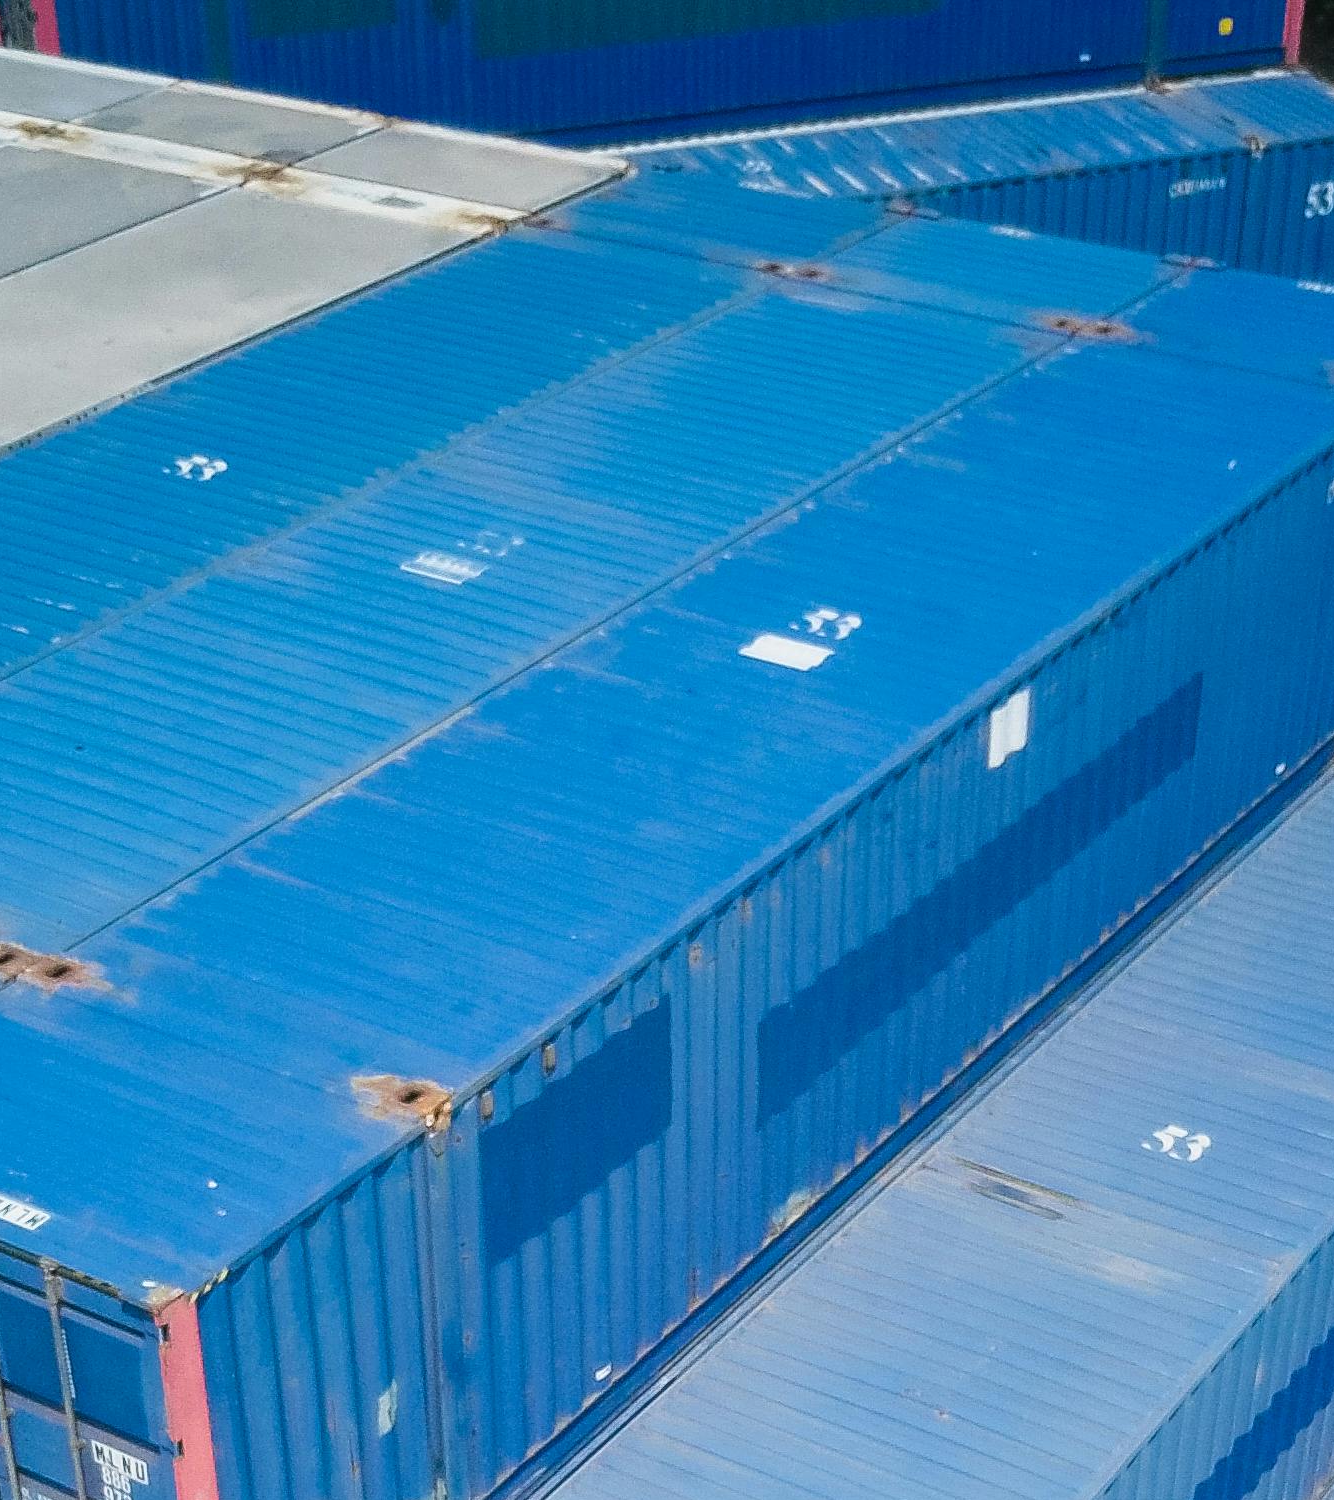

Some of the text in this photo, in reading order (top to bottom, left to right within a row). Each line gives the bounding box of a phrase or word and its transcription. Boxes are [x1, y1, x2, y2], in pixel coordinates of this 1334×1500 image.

[1140, 1123, 1213, 1164] 53
[92, 1440, 148, 1485] MLNU
[101, 1466, 131, 1494] 886
